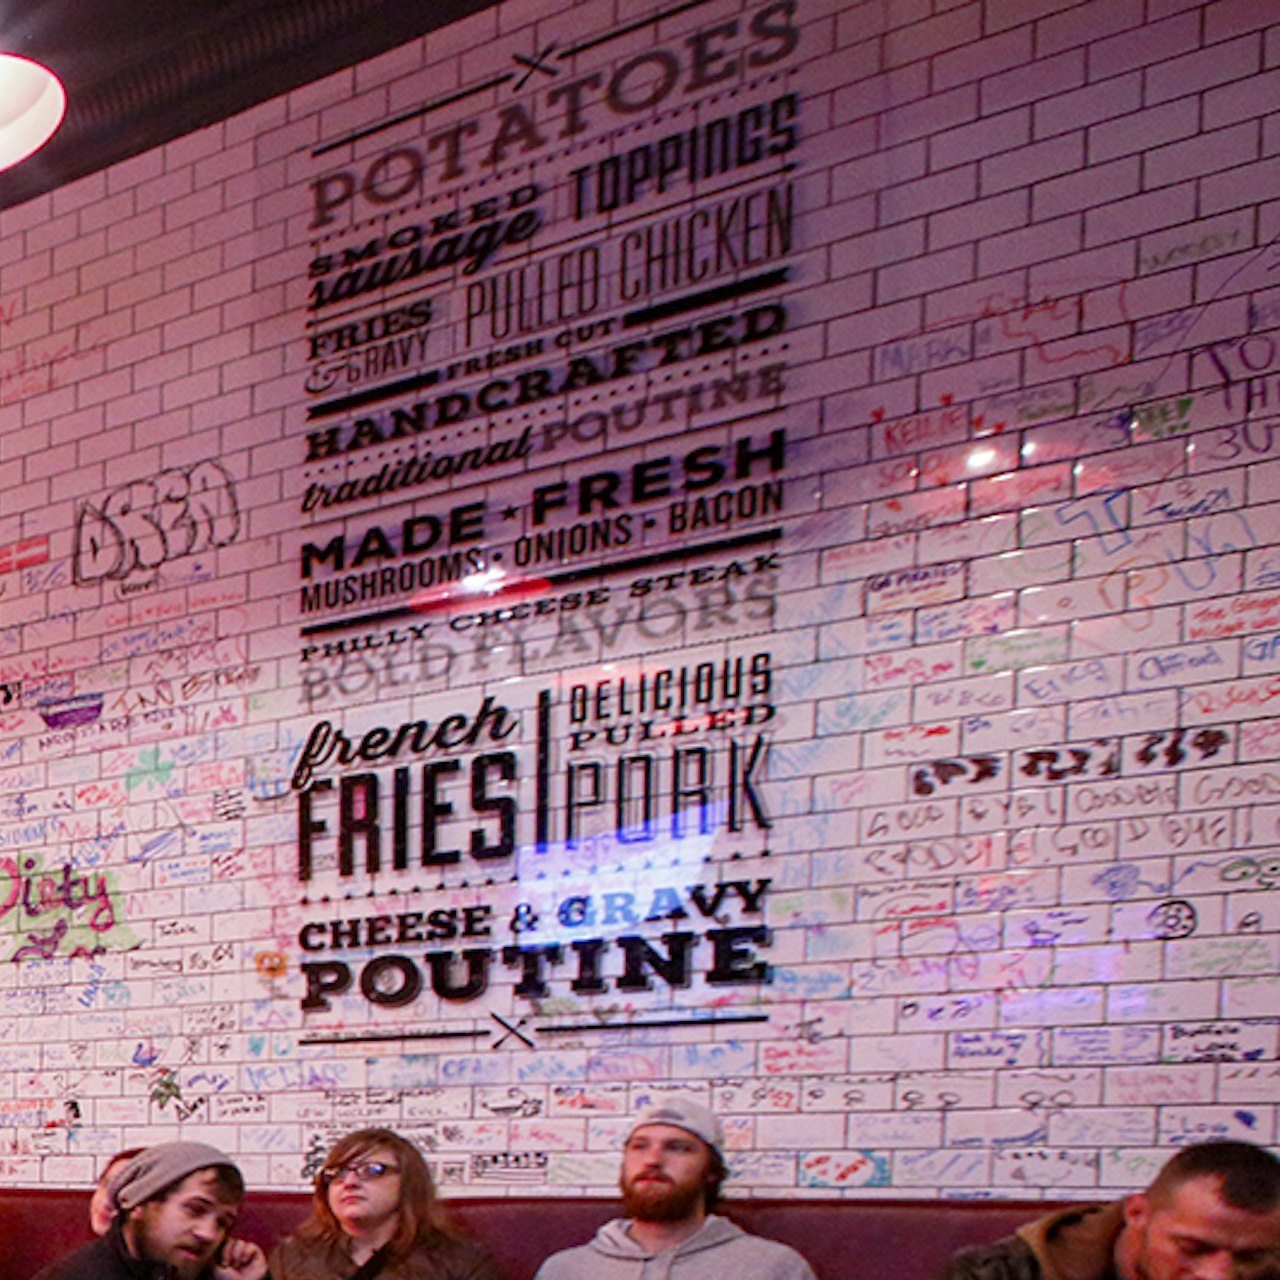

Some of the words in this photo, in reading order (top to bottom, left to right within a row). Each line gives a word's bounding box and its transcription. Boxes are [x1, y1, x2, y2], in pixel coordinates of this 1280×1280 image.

[308, 0, 800, 230] POTATOES
[570, 92, 798, 220] TOPPINGS
[306, 207, 542, 311] sausage
[308, 183, 541, 278] SMOKED
[465, 247, 600, 347] PULLED
[620, 182, 795, 301] CHICKEN
[305, 303, 788, 463] HANDCRAFTED
[306, 299, 433, 360] FRIES
[346, 330, 431, 384] GRAVY
[445, 339, 545, 380] FRESH
[555, 316, 619, 351] CUT
[301, 426, 534, 513] traditional
[540, 362, 787, 451] POUTINE
[300, 548, 484, 615] MUSHROOMS
[514, 514, 633, 568] ONIONS
[669, 483, 784, 535] BACON
[301, 502, 487, 578] MADE
[532, 428, 786, 527] FRESH
[298, 643, 454, 702] BOLD
[469, 577, 779, 669] FLAVORS
[300, 623, 428, 662] PHILLY
[451, 588, 611, 632] CHEESE
[628, 551, 783, 589] STEAK
[569, 652, 773, 724] DELICIOUS
[569, 703, 777, 750] PULLED
[292, 697, 518, 792] french
[566, 733, 772, 851] PORK
[298, 750, 517, 881] FRIES
[299, 904, 491, 952] CHEESE
[509, 903, 538, 935] &
[557, 878, 773, 929] GRAVY
[300, 926, 774, 1012] POUTINE
